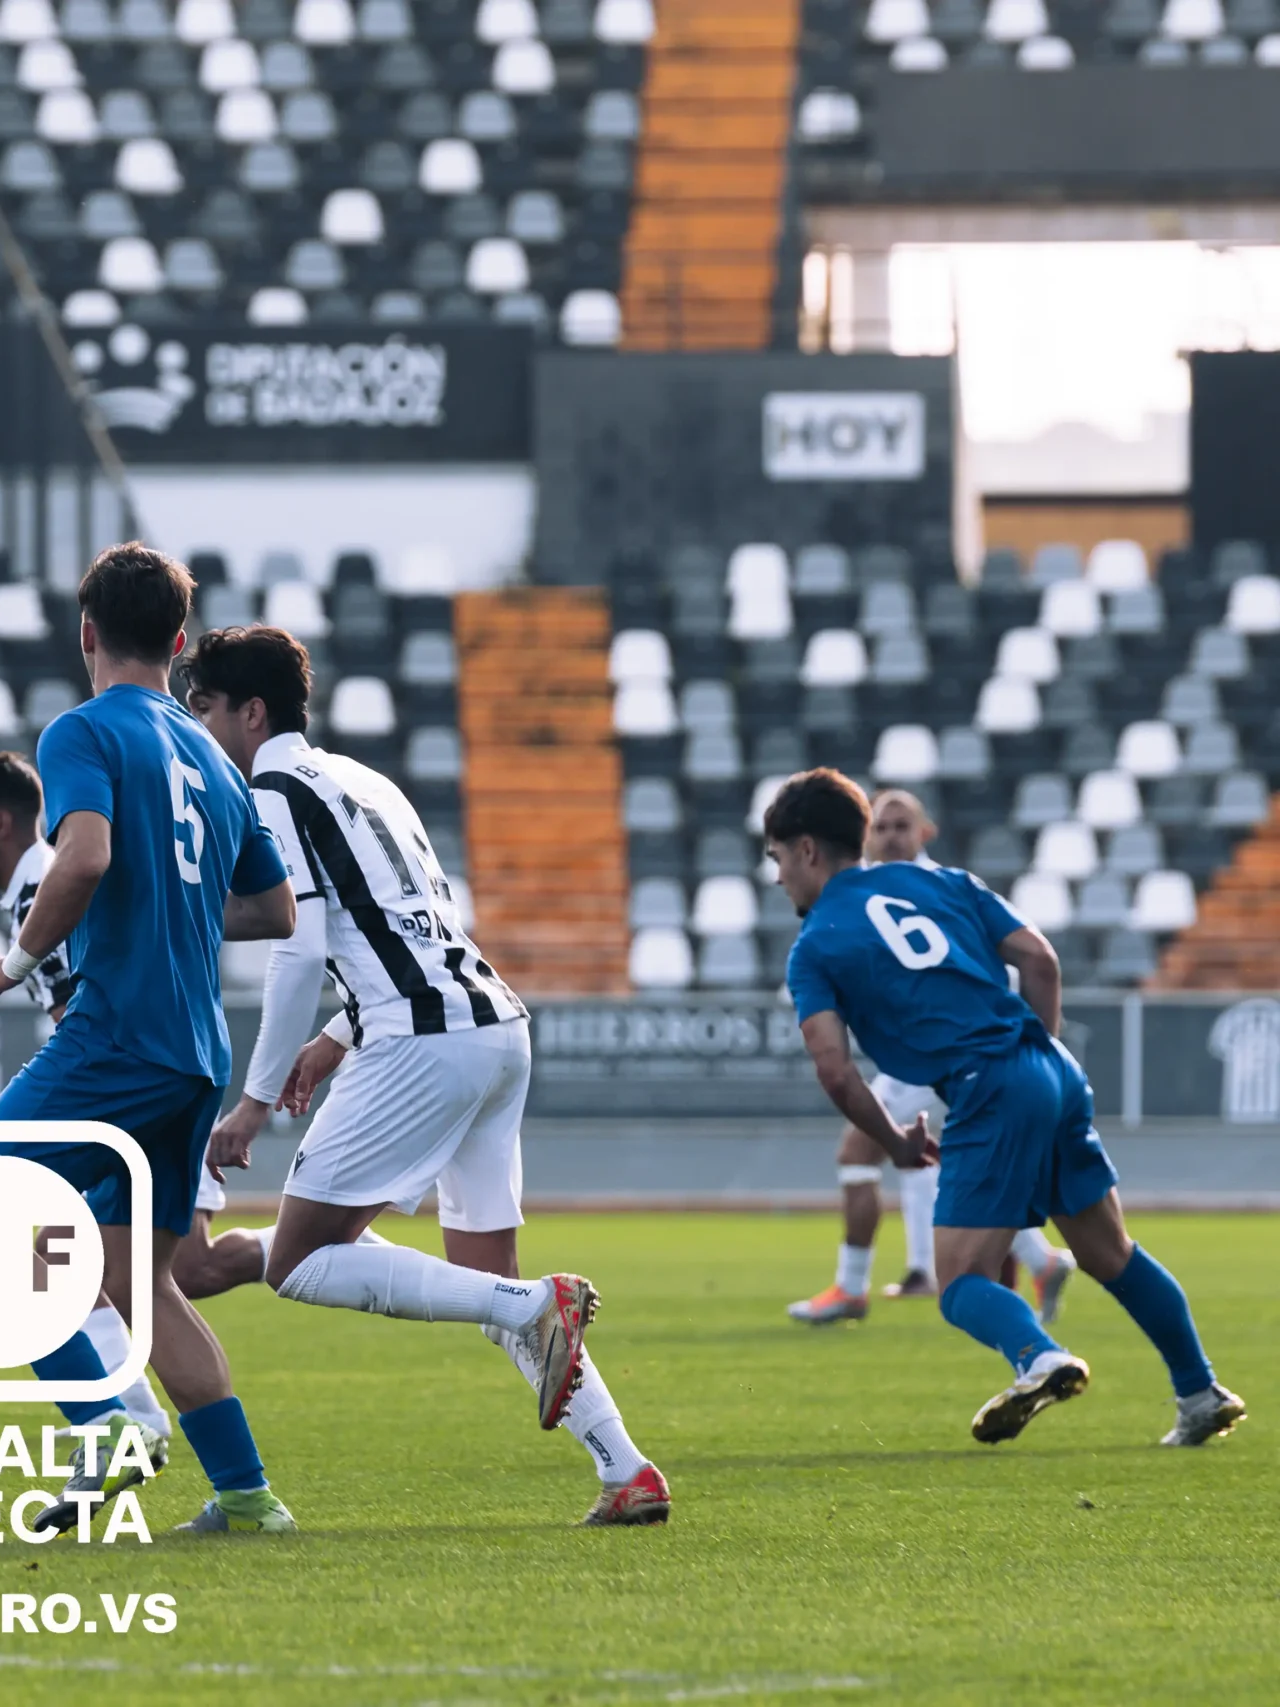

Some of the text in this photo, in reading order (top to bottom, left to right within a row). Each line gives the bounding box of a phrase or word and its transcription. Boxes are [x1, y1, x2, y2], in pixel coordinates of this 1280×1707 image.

[776, 413, 910, 458] HOY
[170, 756, 206, 885] 5
[865, 894, 951, 970] 6
